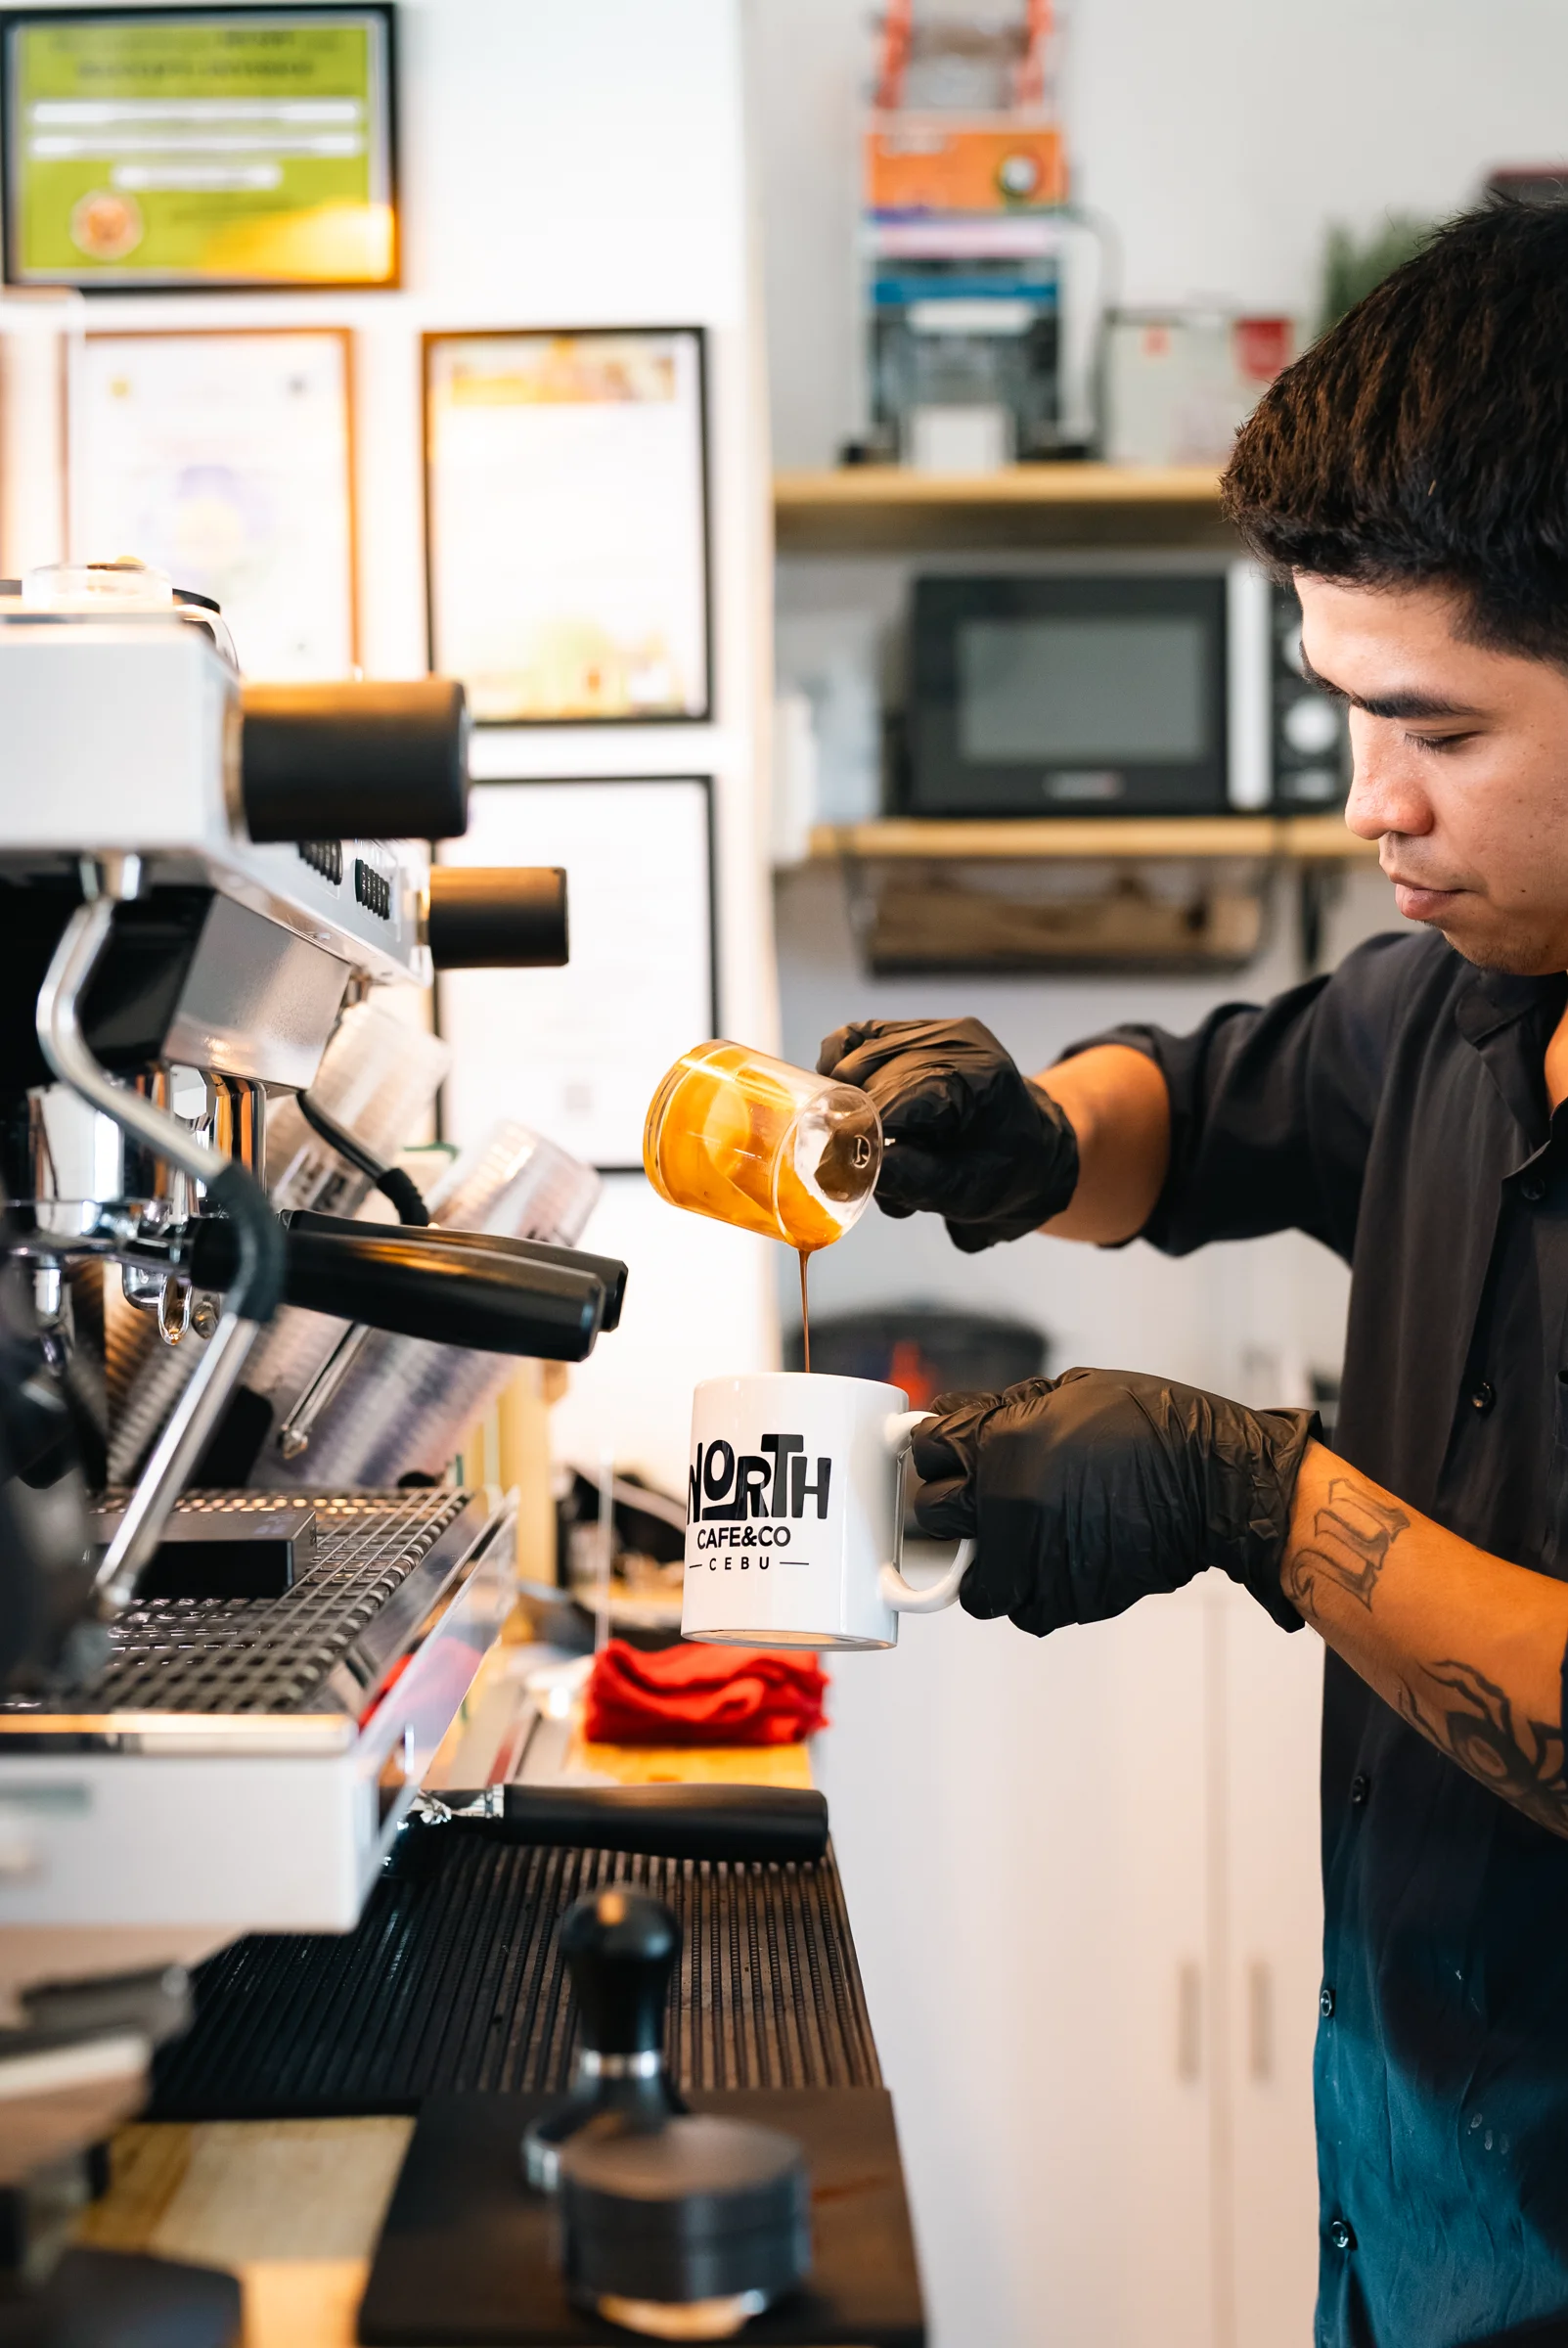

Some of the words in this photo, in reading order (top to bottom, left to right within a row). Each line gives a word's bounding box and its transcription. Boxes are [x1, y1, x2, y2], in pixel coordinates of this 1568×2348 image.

[687, 1433, 831, 1525] NORTH
[697, 1525, 791, 1550] CAFE&CO
[709, 1557, 770, 1571] CEBU
